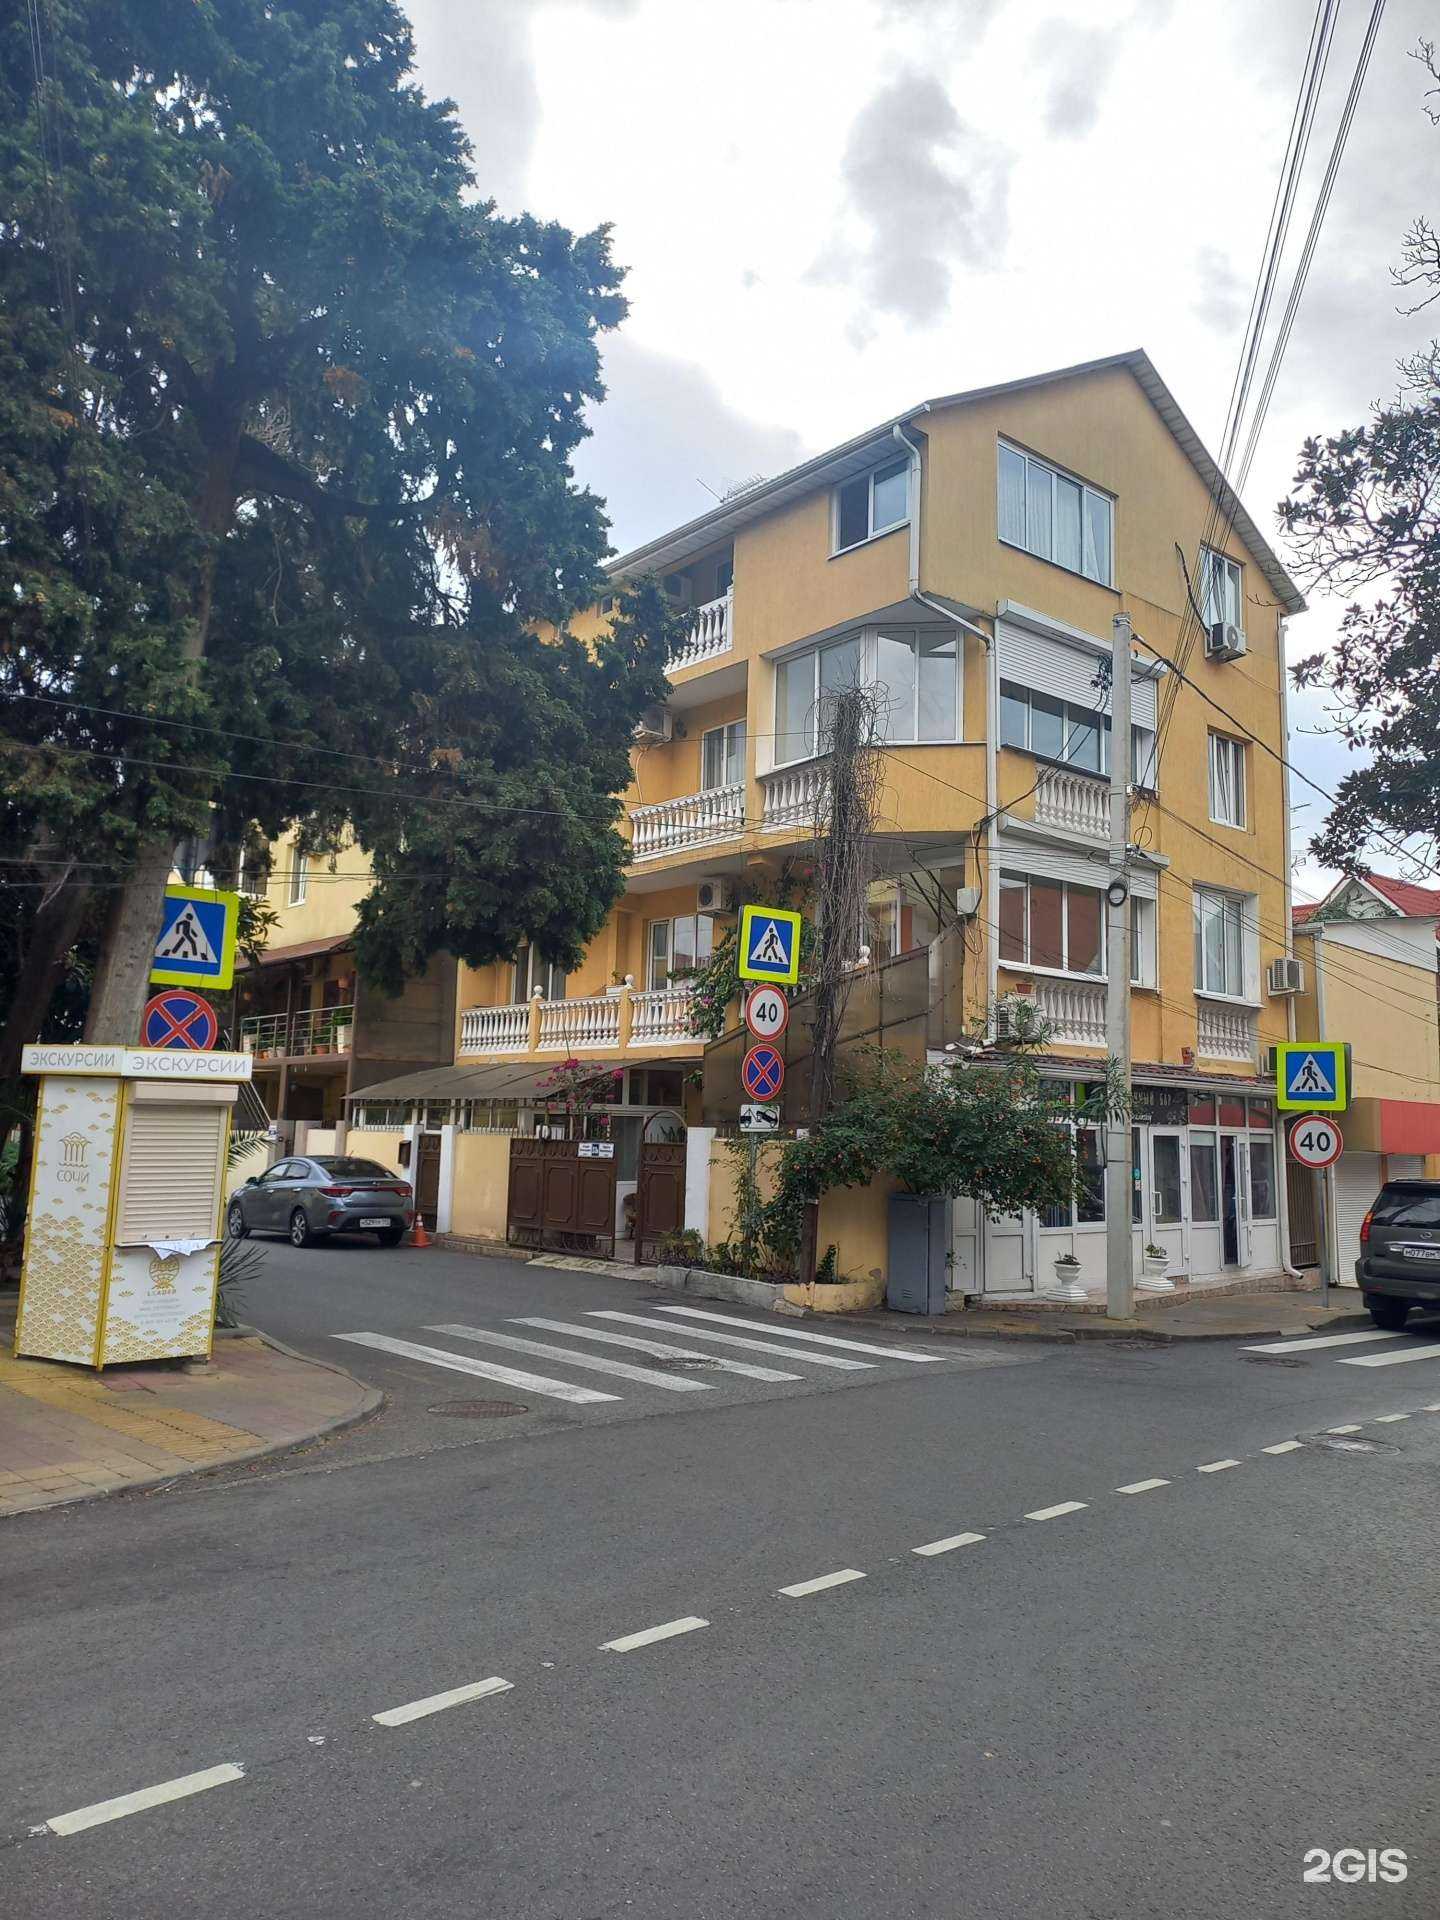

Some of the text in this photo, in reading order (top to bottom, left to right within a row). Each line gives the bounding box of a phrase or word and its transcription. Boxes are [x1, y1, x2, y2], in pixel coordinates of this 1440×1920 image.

[756, 1002, 778, 1023] 40
[30, 1052, 115, 1067] ЭКСКУРСИИ
[132, 1056, 247, 1073] ЭКСКУРСИИ
[1299, 1131, 1331, 1152] 40
[57, 1170, 90, 1184] СОЧИ
